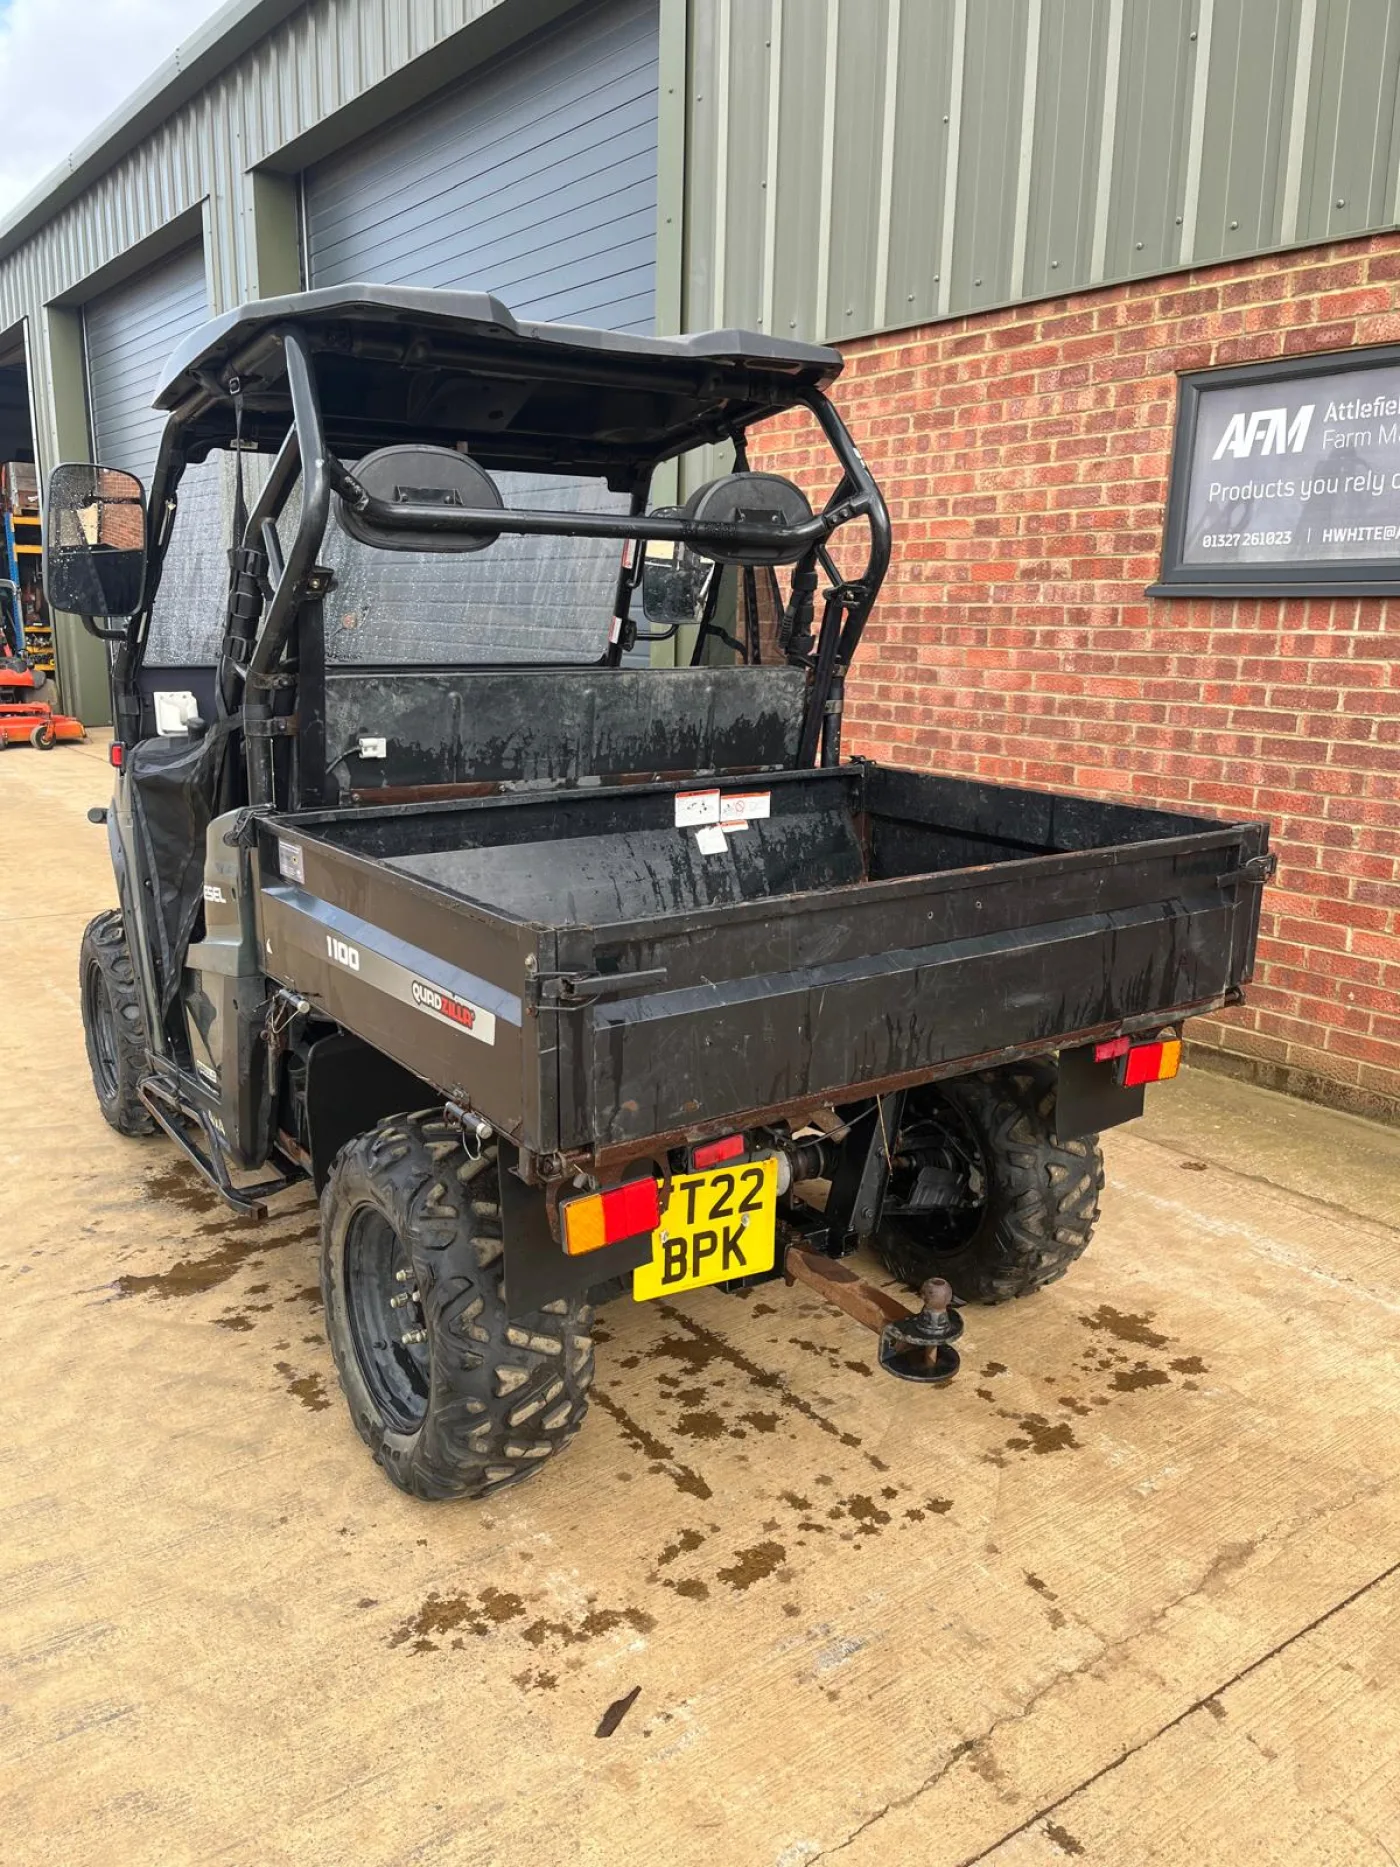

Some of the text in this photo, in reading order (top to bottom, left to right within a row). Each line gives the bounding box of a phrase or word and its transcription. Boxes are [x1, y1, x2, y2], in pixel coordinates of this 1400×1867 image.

[1212, 405, 1316, 461] AFM
[1322, 423, 1400, 450] Farm M
[1208, 481, 1294, 502] Products
[1300, 475, 1338, 501] you
[1344, 470, 1385, 496] rely
[1202, 533, 1240, 548] 01327
[1242, 530, 1292, 546] 261023
[326, 935, 360, 972] 1100
[411, 979, 475, 1031] QUADZILLA
[658, 1168, 765, 1225] T22
[661, 1225, 747, 1286] BPK
